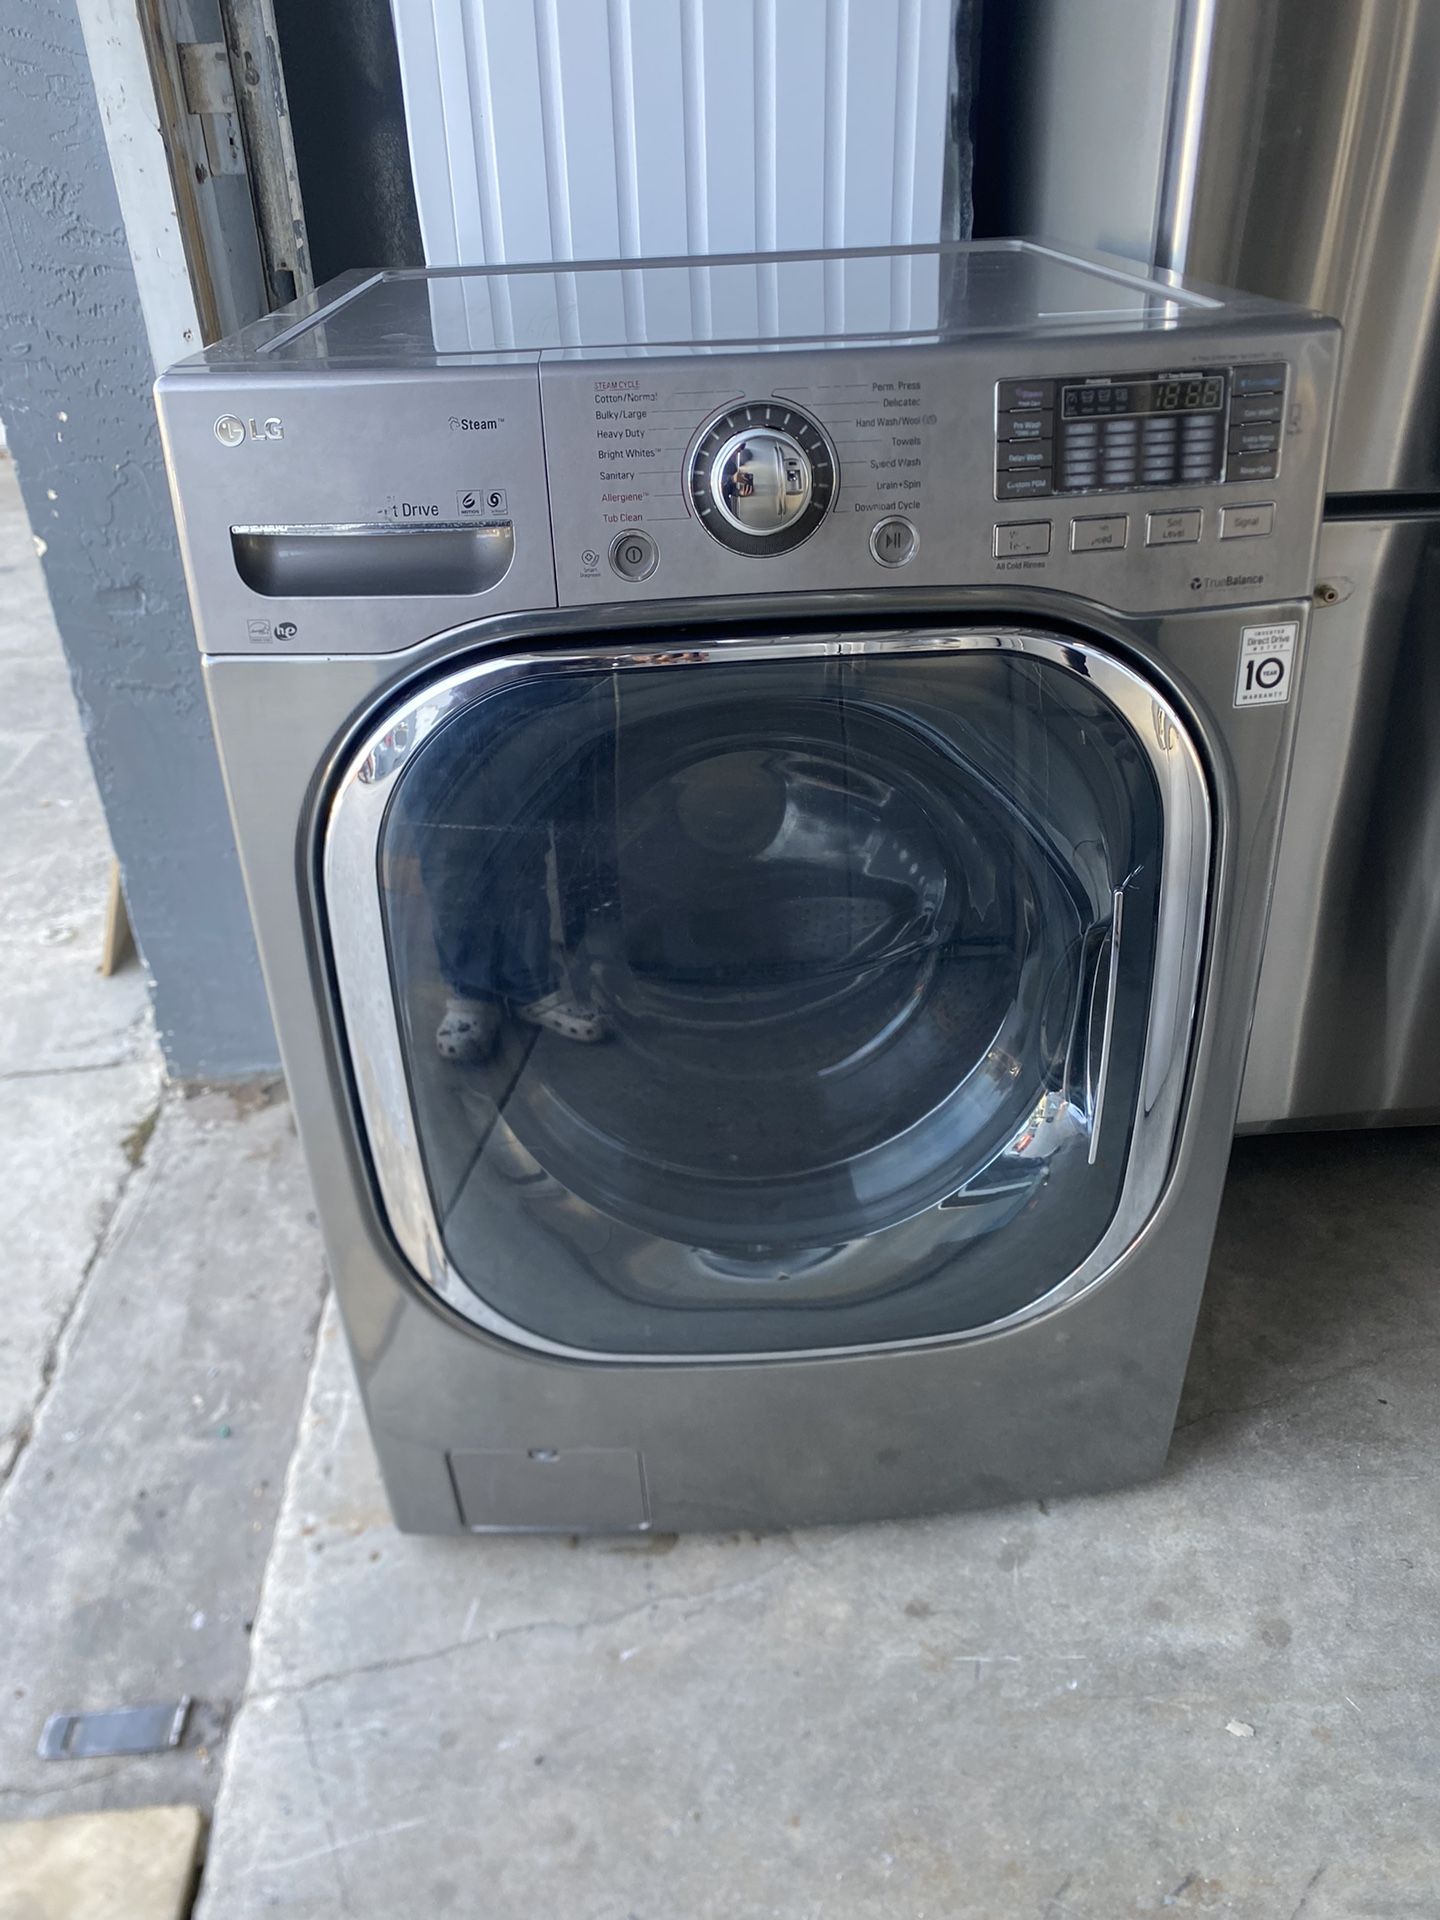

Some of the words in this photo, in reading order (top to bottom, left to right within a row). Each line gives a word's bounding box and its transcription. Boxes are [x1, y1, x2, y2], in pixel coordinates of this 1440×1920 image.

[898, 381, 921, 390] Press
[595, 410, 647, 420] Bulky/Large
[248, 417, 285, 441] LG
[597, 430, 624, 440] Heavy
[625, 429, 646, 439] Duty
[598, 449, 624, 461] Bright
[600, 470, 635, 481] Sanitary
[402, 503, 439, 517] Drive
[854, 501, 896, 512] Download
[897, 500, 921, 511] Cycle
[603, 514, 619, 523] Tub
[620, 513, 643, 522] Clean
[1246, 657, 1285, 691] 10
